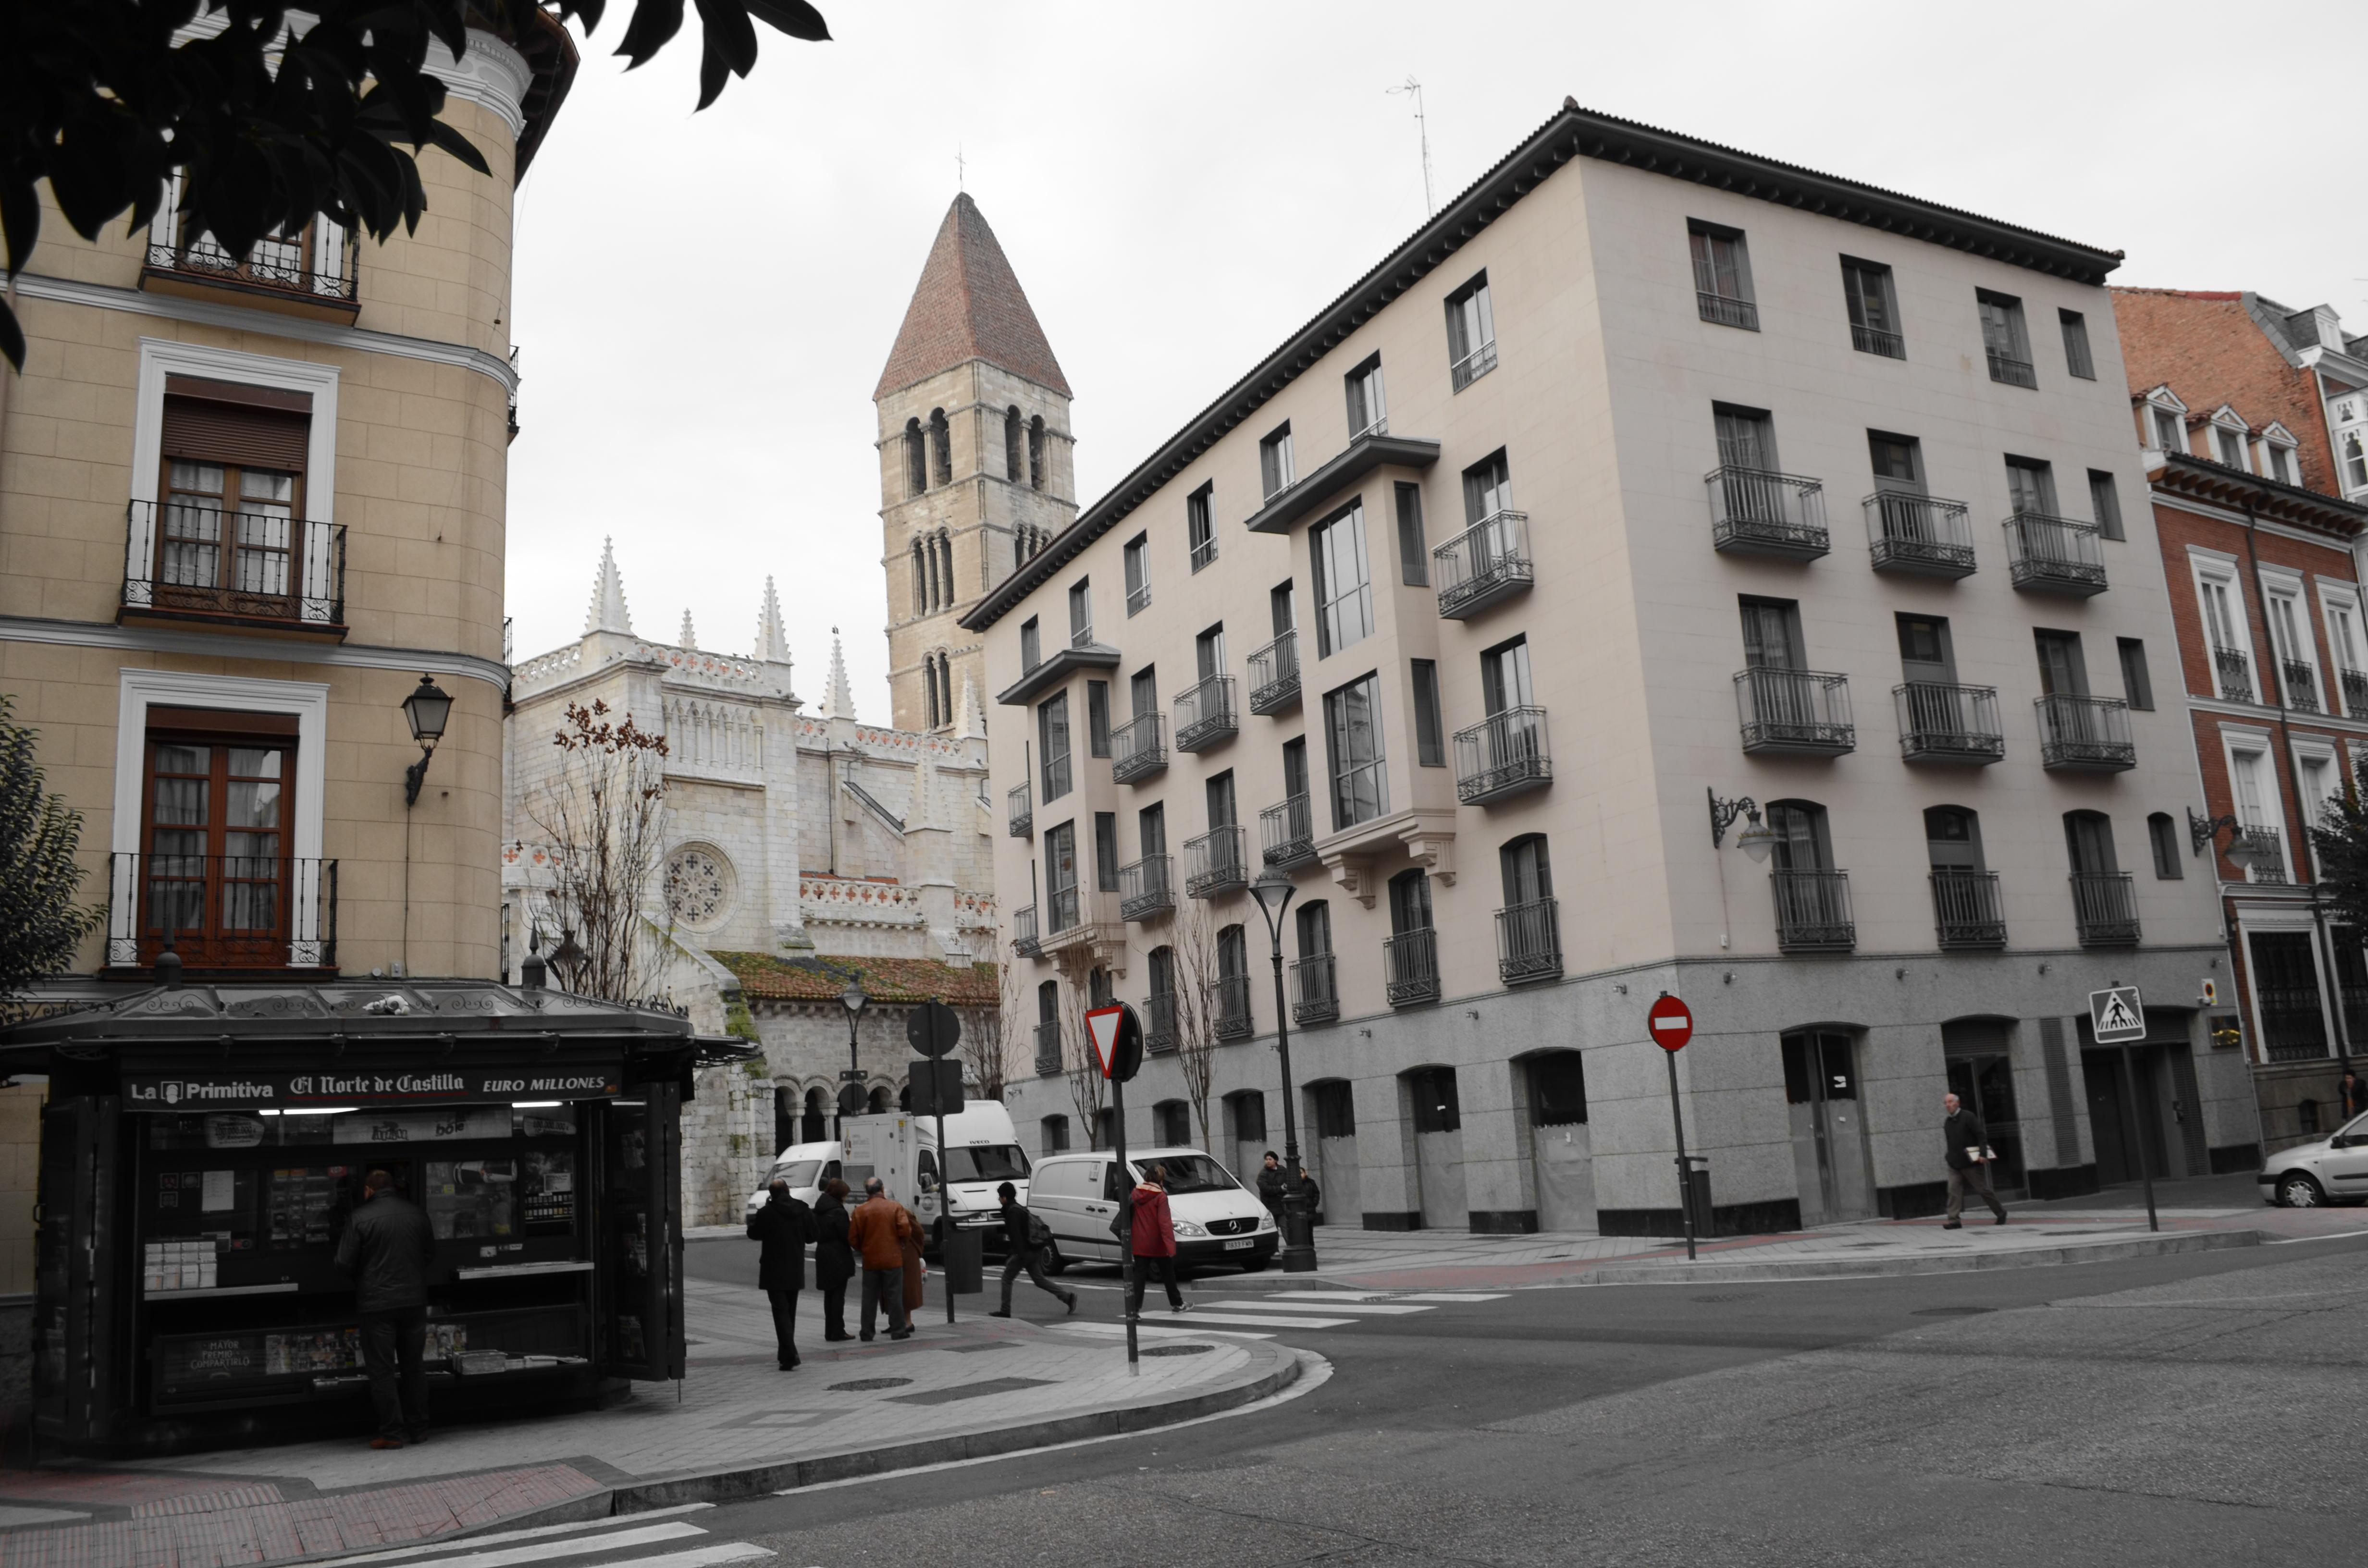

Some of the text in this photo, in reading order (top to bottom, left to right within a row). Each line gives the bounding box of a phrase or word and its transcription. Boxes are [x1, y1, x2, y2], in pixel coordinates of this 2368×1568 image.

[131, 1081, 274, 1100] La Primitiva
[289, 1074, 465, 1094] El Norte de Castilla
[482, 1079, 525, 1092] EURO
[210, 1339, 239, 1350] MAYOR
[202, 1350, 233, 1360] PREMIO
[190, 1356, 250, 1370] COMPARTIRLO
